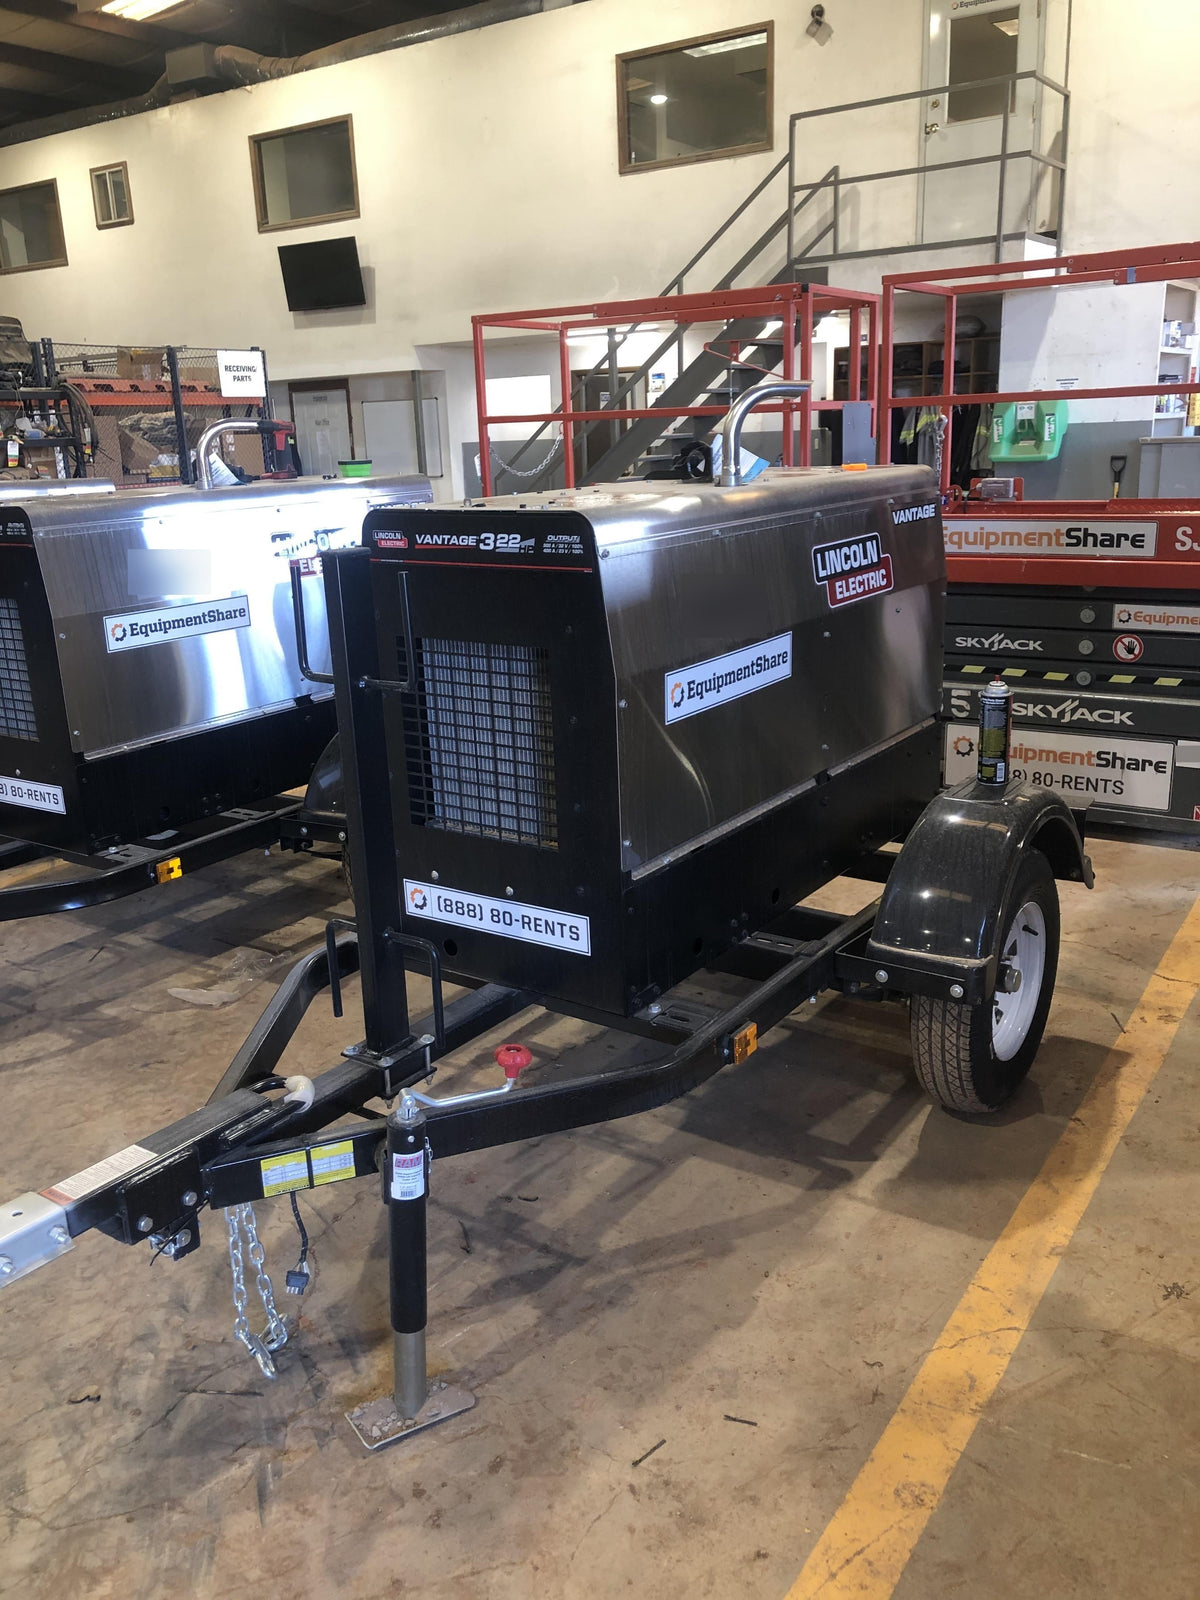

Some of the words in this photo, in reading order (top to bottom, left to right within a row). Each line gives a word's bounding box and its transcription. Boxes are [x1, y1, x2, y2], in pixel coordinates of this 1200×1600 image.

[892, 503, 937, 525] VANTAGE
[374, 532, 401, 540] LINCOLN
[415, 534, 478, 547] VANTAGE
[479, 533, 521, 550] 322
[816, 540, 879, 578] LINCOLN
[835, 568, 888, 600] ELECTRIC
[128, 607, 246, 637] EquipmentShare
[955, 632, 1044, 651] SKYJACK
[687, 650, 788, 700] EquipmentShare
[1012, 699, 1135, 725] SKYJACK
[1007, 743, 1167, 774] uipmentShare
[10, 785, 59, 805] 80-RENTS
[1032, 771, 1124, 796] 80-RENTS
[437, 895, 483, 922] (888)
[490, 908, 580, 942] 80-RENTS
